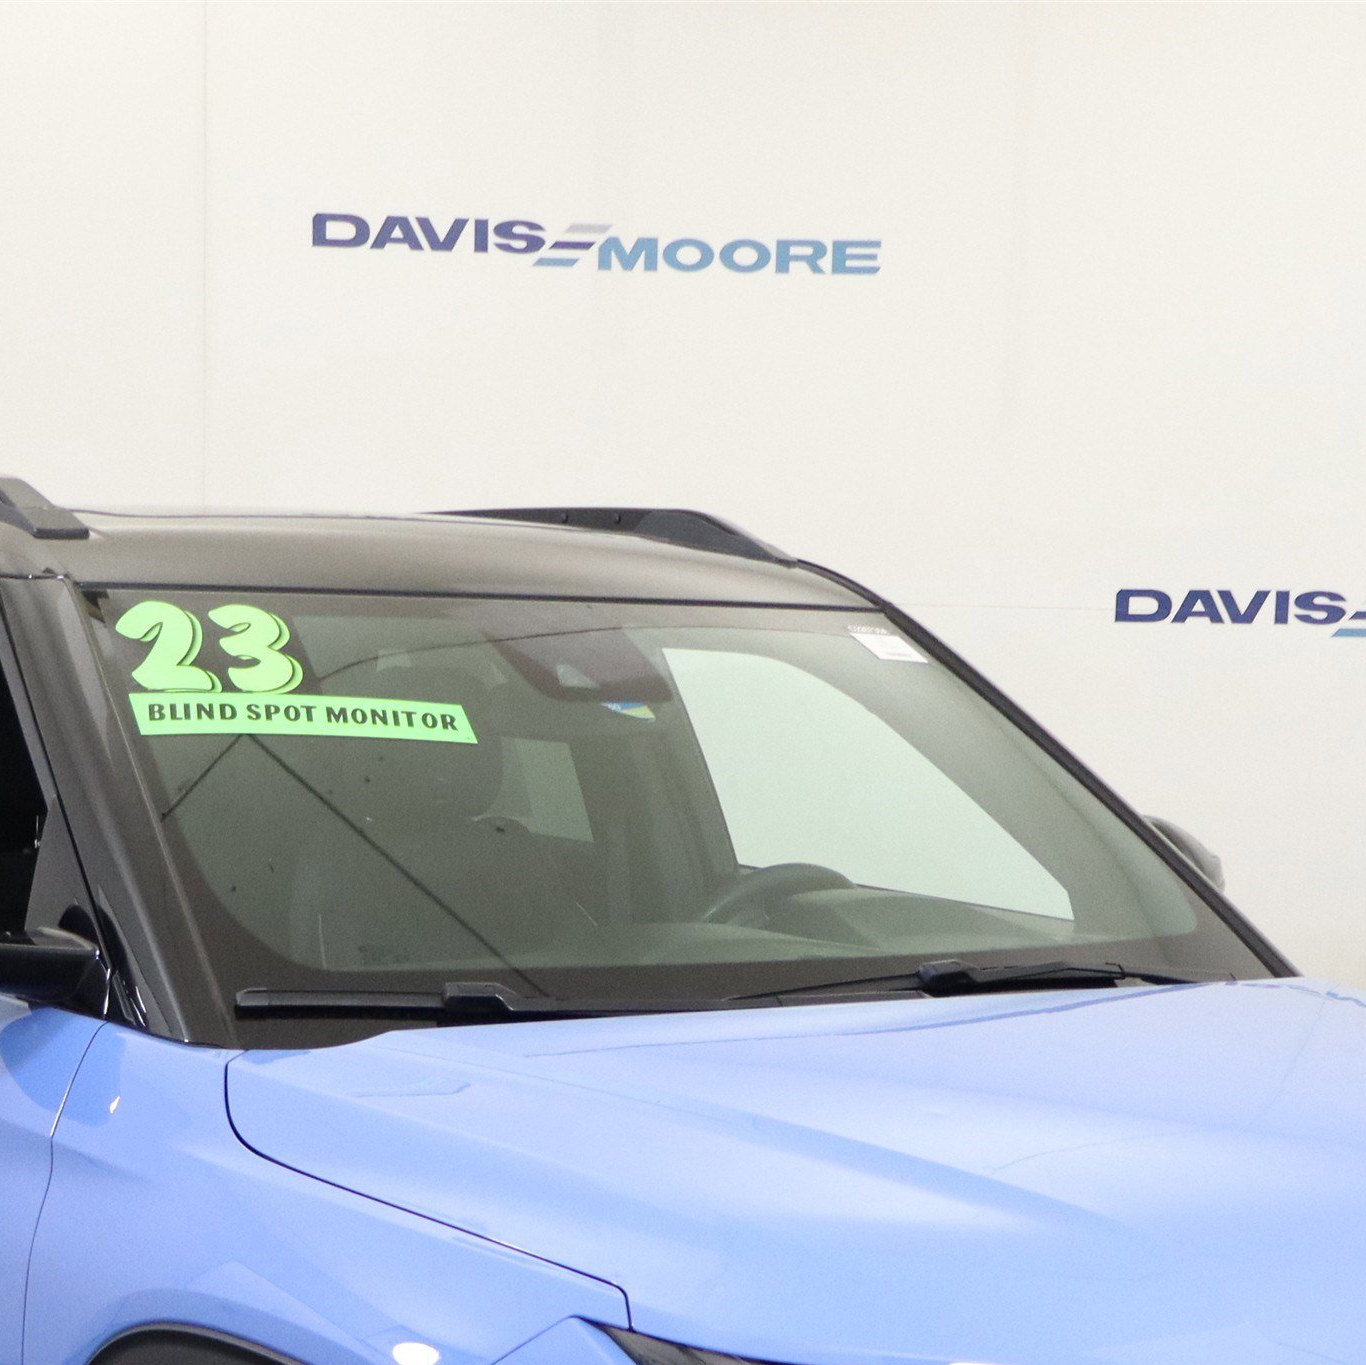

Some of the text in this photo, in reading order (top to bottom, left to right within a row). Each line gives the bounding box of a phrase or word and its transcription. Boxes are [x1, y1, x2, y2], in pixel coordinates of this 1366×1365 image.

[313, 213, 881, 274] DAVIS MOORE
[1115, 588, 1346, 624] DAVIS
[115, 600, 303, 694] 23
[148, 702, 459, 731] BLIND SPOT MONITOR
